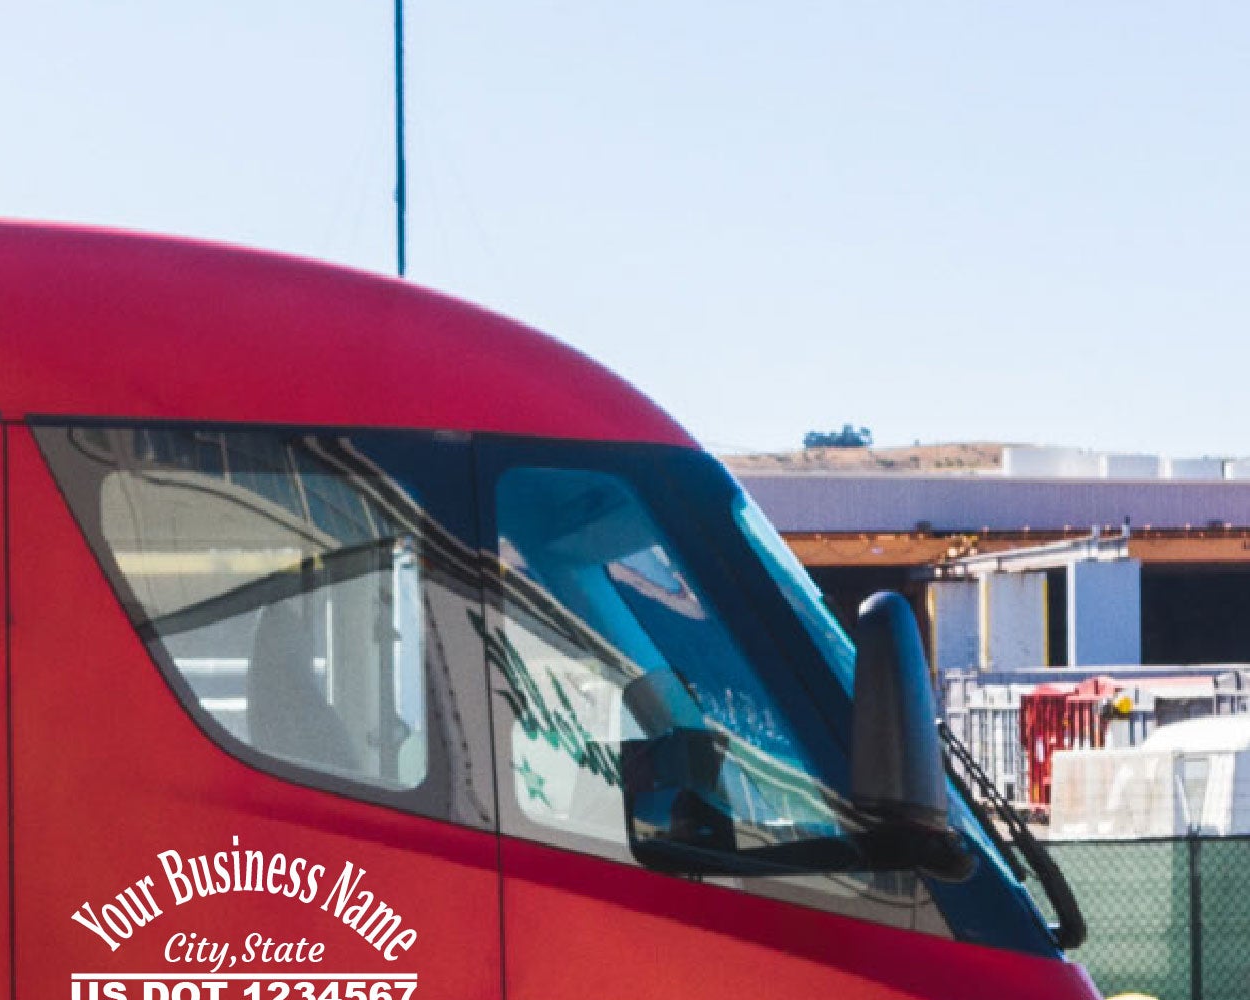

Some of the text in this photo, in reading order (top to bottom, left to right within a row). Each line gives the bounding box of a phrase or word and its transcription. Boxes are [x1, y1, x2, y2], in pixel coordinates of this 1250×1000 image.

[70, 835, 418, 962] Your Business Name
